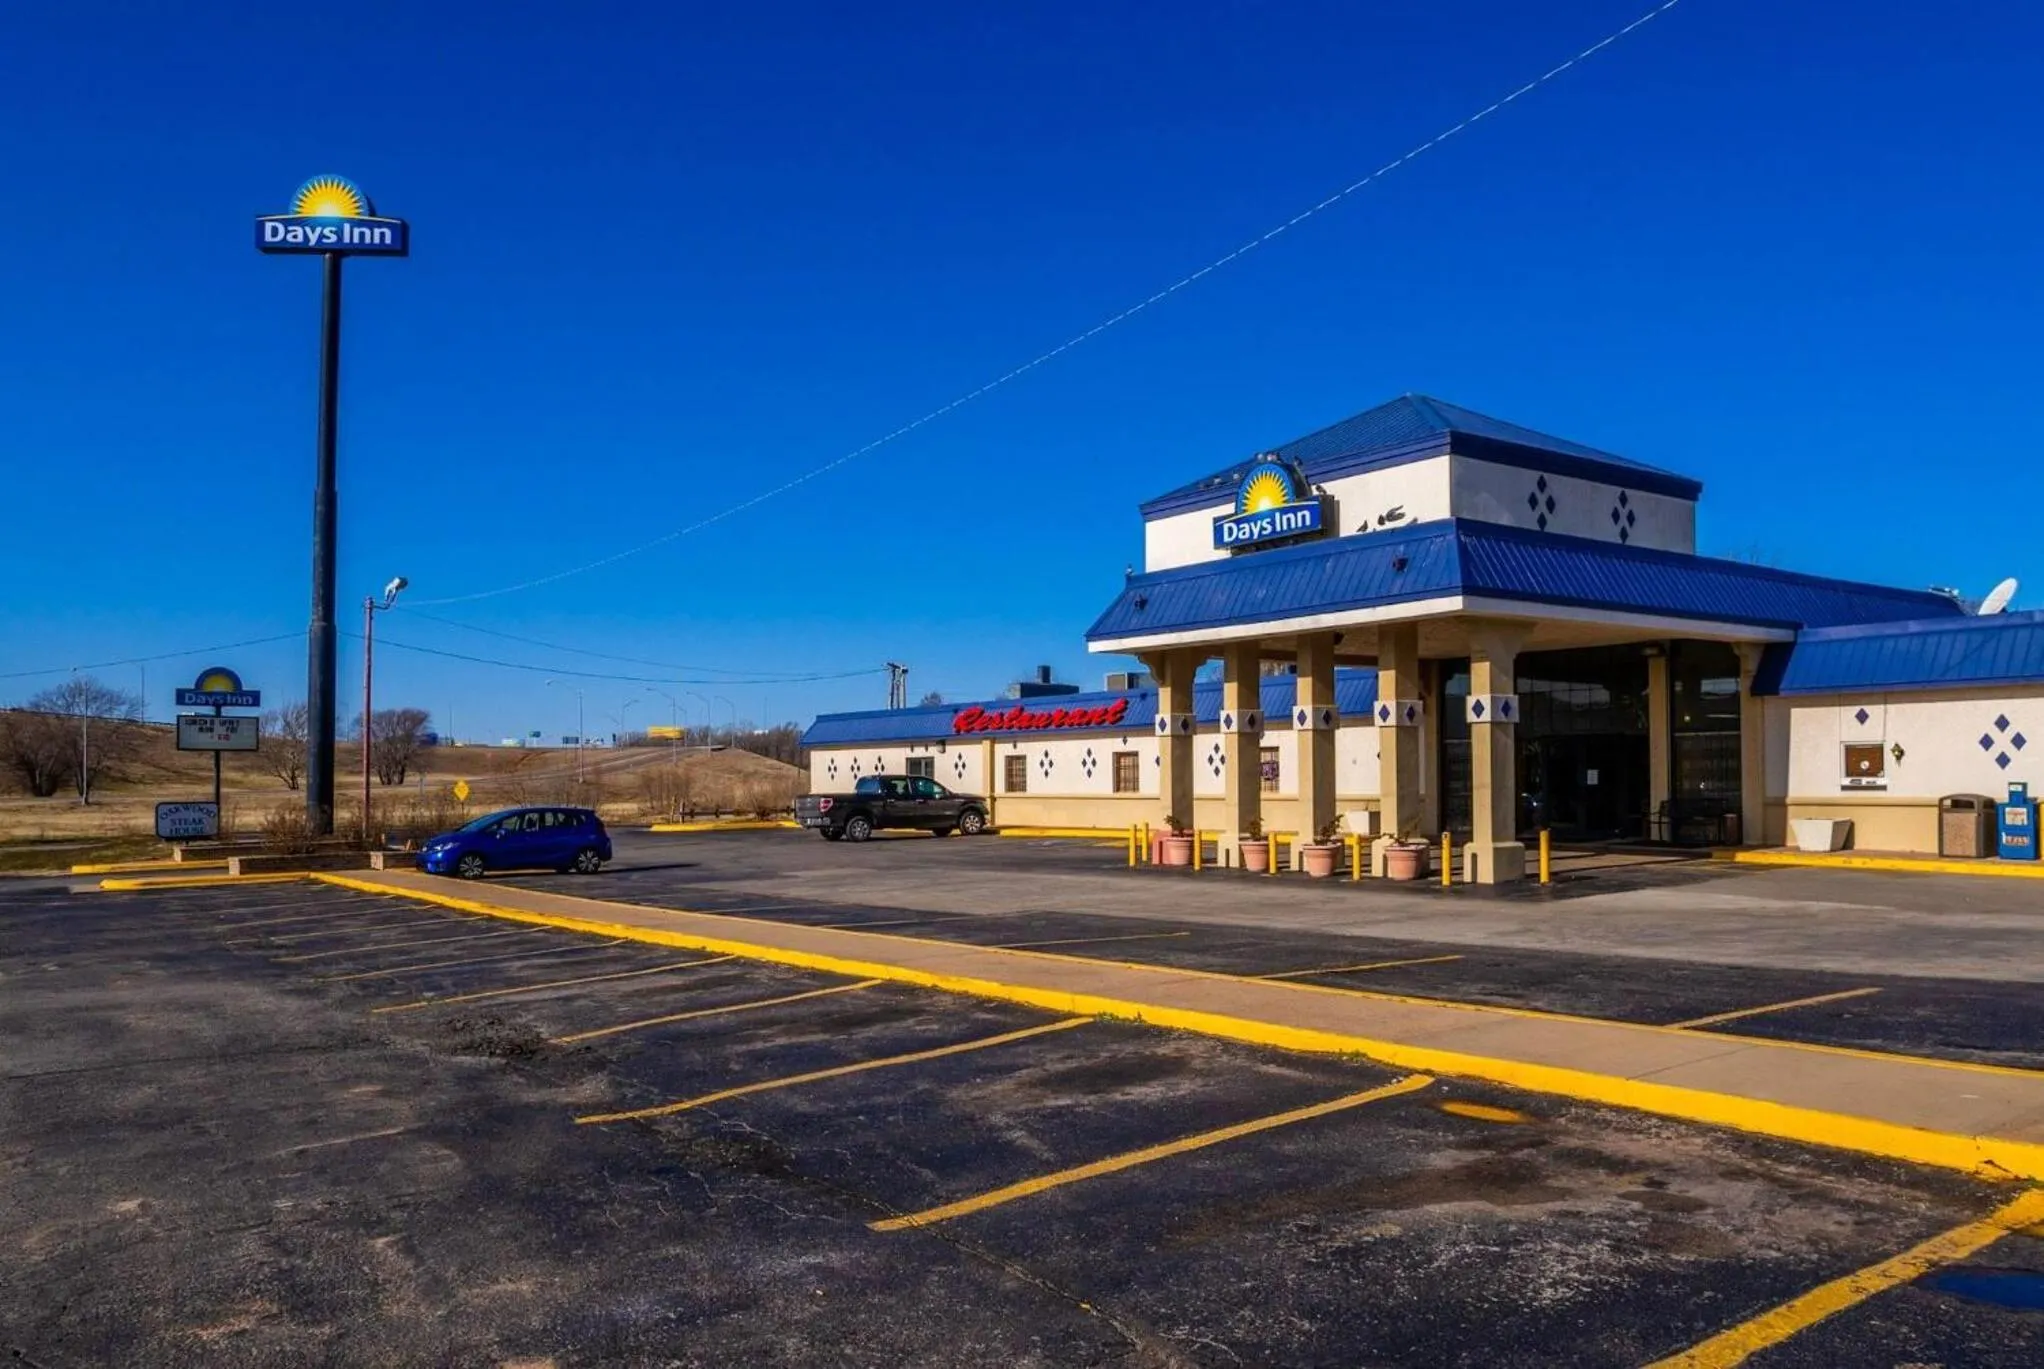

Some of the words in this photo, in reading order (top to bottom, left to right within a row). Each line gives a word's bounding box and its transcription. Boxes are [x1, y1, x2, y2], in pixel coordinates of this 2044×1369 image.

[264, 221, 338, 246] Days
[343, 223, 392, 244] Inn
[1223, 518, 1273, 543] Days
[1275, 510, 1311, 532] Inn
[184, 693, 223, 705] Days
[227, 694, 253, 705] Inn
[954, 698, 1128, 734] Restaurant
